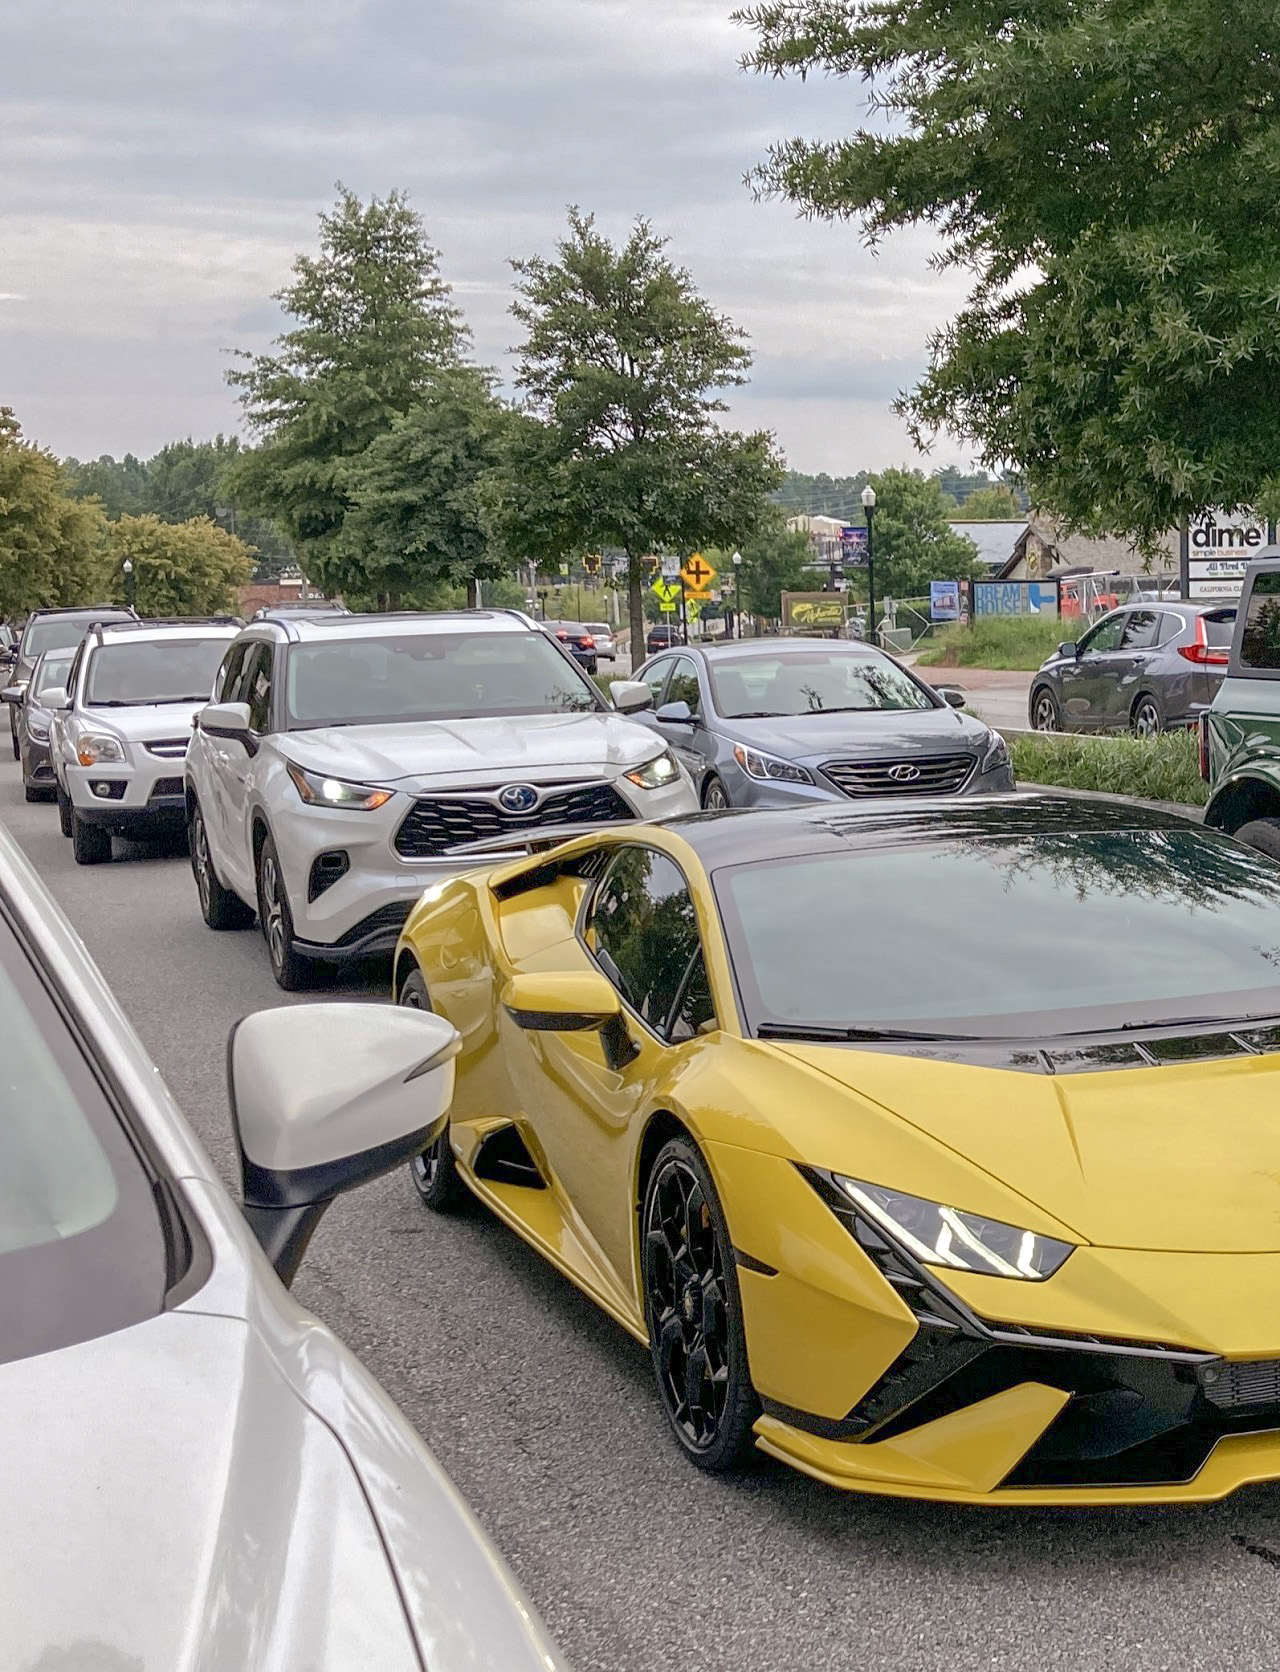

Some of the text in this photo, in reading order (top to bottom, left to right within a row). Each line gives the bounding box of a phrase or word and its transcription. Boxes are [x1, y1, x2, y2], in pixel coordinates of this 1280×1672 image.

[1192, 522, 1262, 547] dime
[1192, 549, 1216, 557] simple
[1206, 563, 1218, 571] All
[1220, 562, 1239, 571] Fired
[975, 585, 1020, 600] DREAM
[976, 599, 1020, 615] HOUSE
